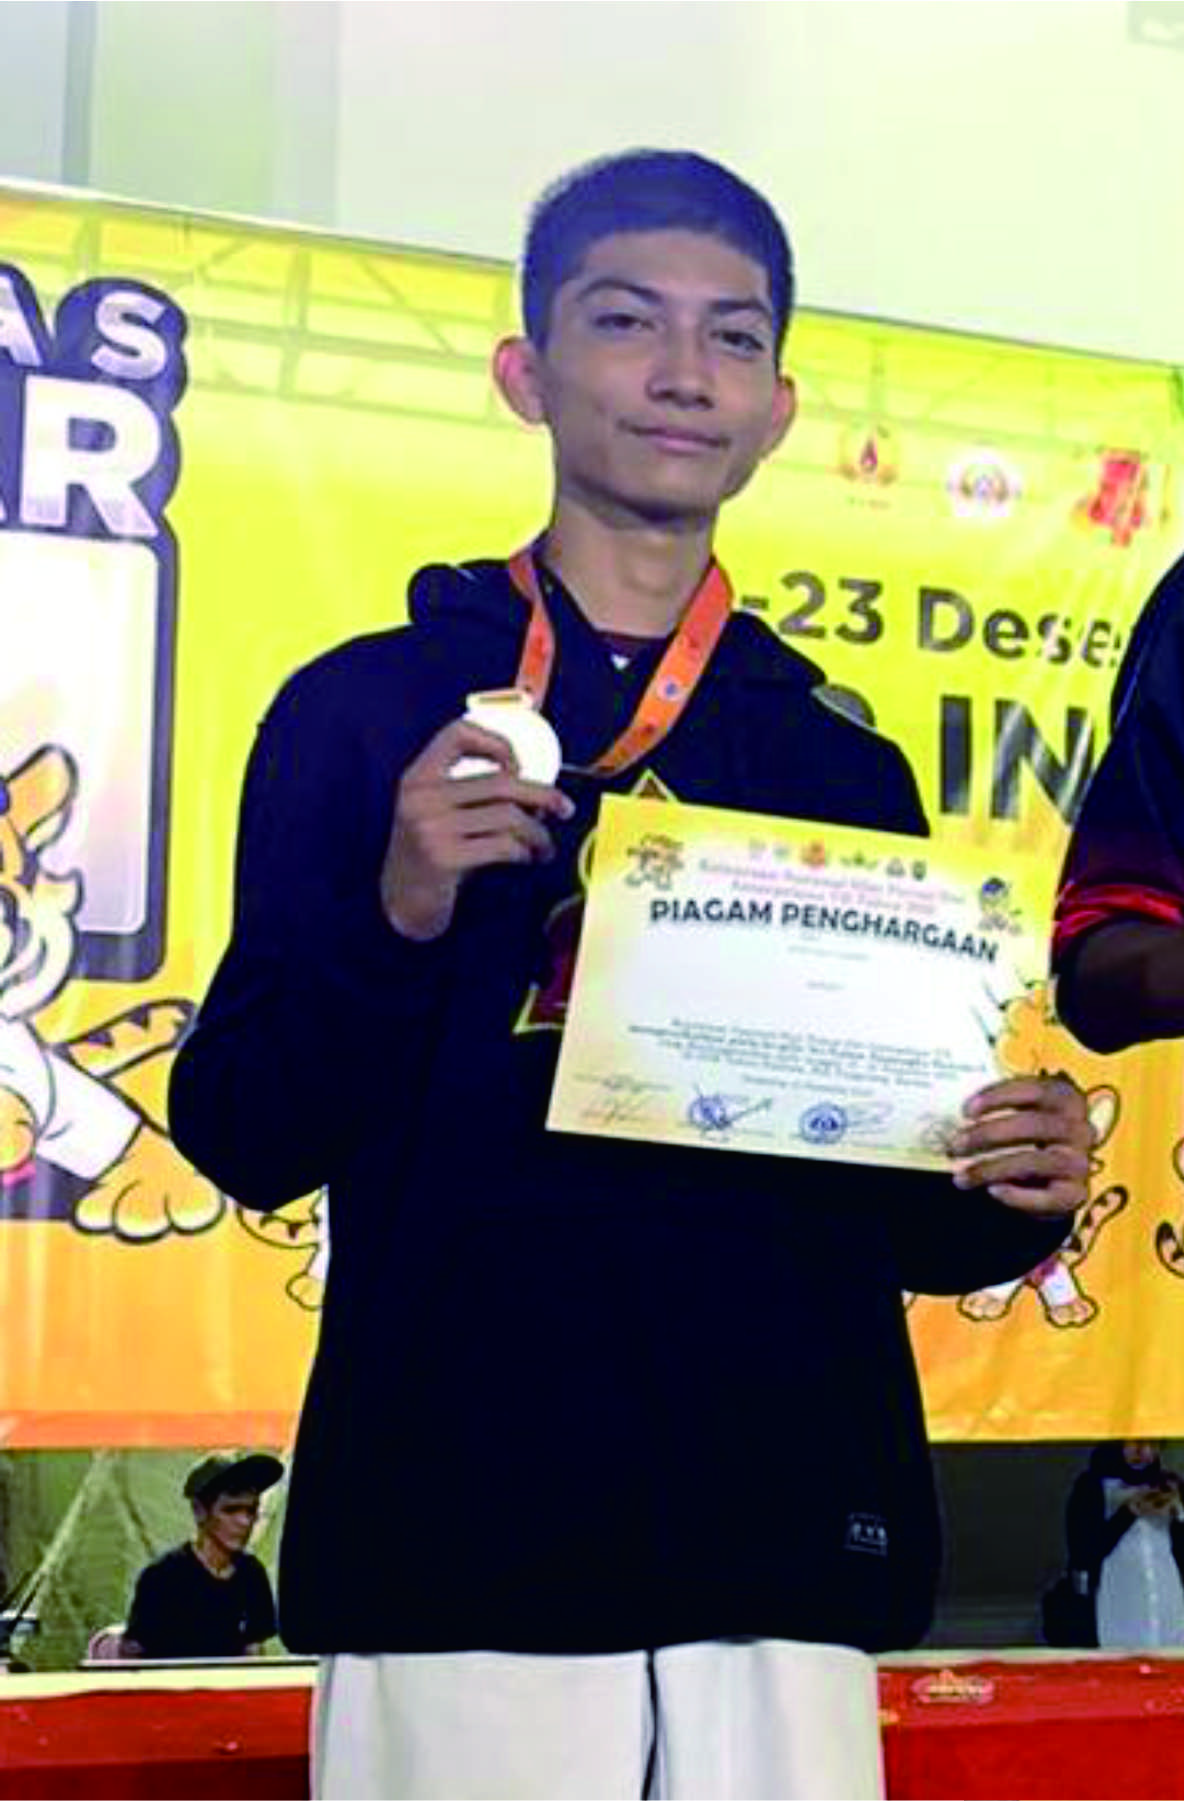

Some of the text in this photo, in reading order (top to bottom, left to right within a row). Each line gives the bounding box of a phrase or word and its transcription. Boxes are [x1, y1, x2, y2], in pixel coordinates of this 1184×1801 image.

[0, 373, 159, 538] R
[650, 899, 773, 924] PIAGAM
[781, 903, 999, 964] PENGHARGAAN
